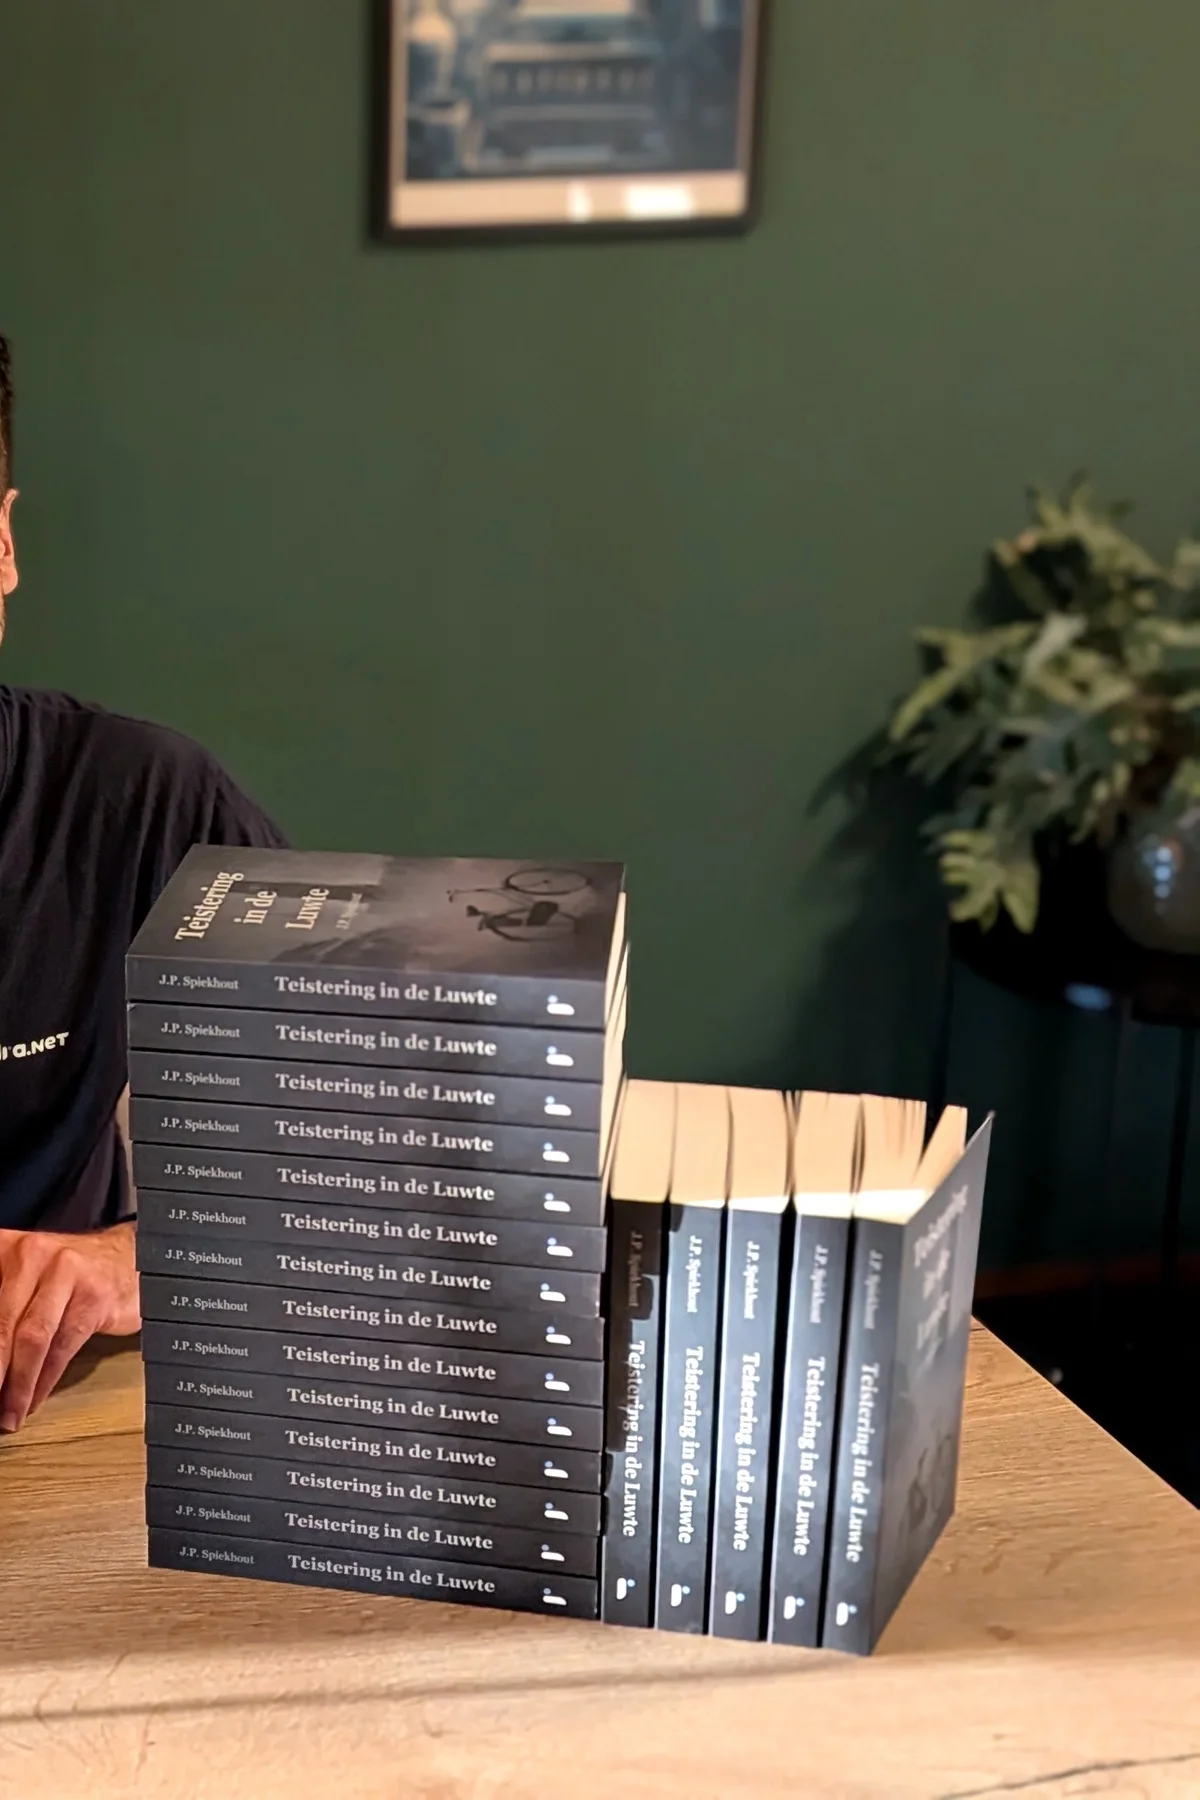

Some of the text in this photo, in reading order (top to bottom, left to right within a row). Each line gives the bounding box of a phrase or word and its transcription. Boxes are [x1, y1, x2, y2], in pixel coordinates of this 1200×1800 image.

[174, 871, 244, 941] Teistering
[233, 889, 278, 924] in de
[285, 887, 330, 931] Luwte
[158, 973, 239, 990] J.P. Spiekhout
[273, 975, 498, 1006] Teistering in de Luwte
[160, 1021, 241, 1038] J.P. Spiekhout
[274, 1024, 498, 1057] Teistering in de Luwte
[161, 1069, 241, 1087] J.P. Spiekhout
[274, 1072, 496, 1106] Teistering in de Luwte
[160, 1116, 240, 1133] J.P. Spiekhout
[273, 1119, 495, 1153] Teistering in de Luwte
[163, 1163, 243, 1180] J.P. Spiekhout
[276, 1167, 496, 1202] Teistering in de Luwte
[168, 1208, 247, 1226] J.P. Spiekhout
[280, 1212, 498, 1247] Teistering in de Luwte
[164, 1248, 243, 1267] J.P. Spiekhout
[276, 1254, 492, 1291] Teistering in de Luwte
[170, 1295, 249, 1312] J.P. Spiekhout
[281, 1299, 498, 1334] Teistering in de Luwte
[171, 1339, 249, 1357] J.P. Spiekhout
[282, 1344, 497, 1381] Teistering in de Luwte
[176, 1380, 254, 1399] J.P. Spiekhout
[286, 1387, 500, 1425] Teistering in de Luwte
[174, 1423, 252, 1441] J.P. Spiekhout
[284, 1429, 497, 1468] Teistering in de Luwte
[623, 1341, 645, 1538] Teistering in de Luwte
[678, 1346, 704, 1545] Teistering in de Luwte
[733, 1352, 760, 1551] Teistering in de Luwte
[793, 1356, 826, 1556] Teistering in de Luwte
[846, 1363, 880, 1563] Teistering in de Luwte
[177, 1463, 253, 1482] J.P. Spiekhout
[286, 1470, 497, 1509] Teistering in de Luwte
[175, 1504, 251, 1523] J.P. Spiekhout
[284, 1512, 494, 1550] Teistering in de Luwte
[179, 1546, 255, 1565] J.P. Spiekhout
[287, 1554, 496, 1593] Teistering in de Luwte
